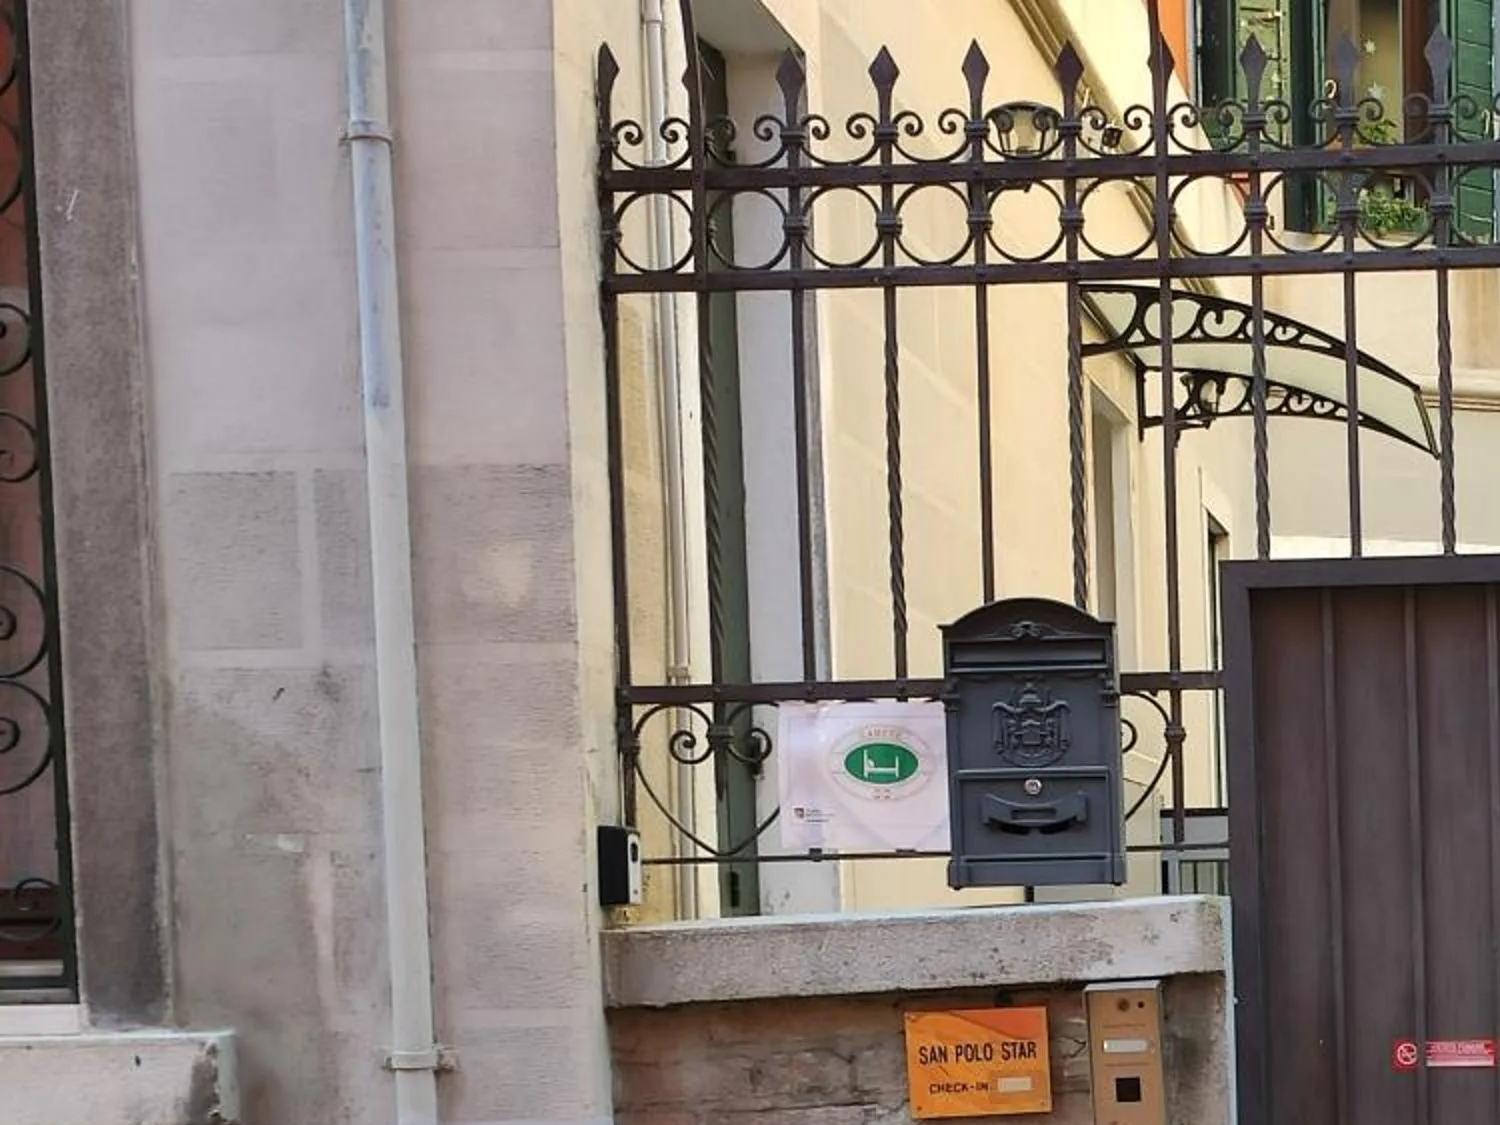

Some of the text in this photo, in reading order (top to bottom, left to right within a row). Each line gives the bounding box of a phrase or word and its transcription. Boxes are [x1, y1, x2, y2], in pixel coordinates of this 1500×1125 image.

[918, 1040, 1037, 1065] SAN POLO STAR
